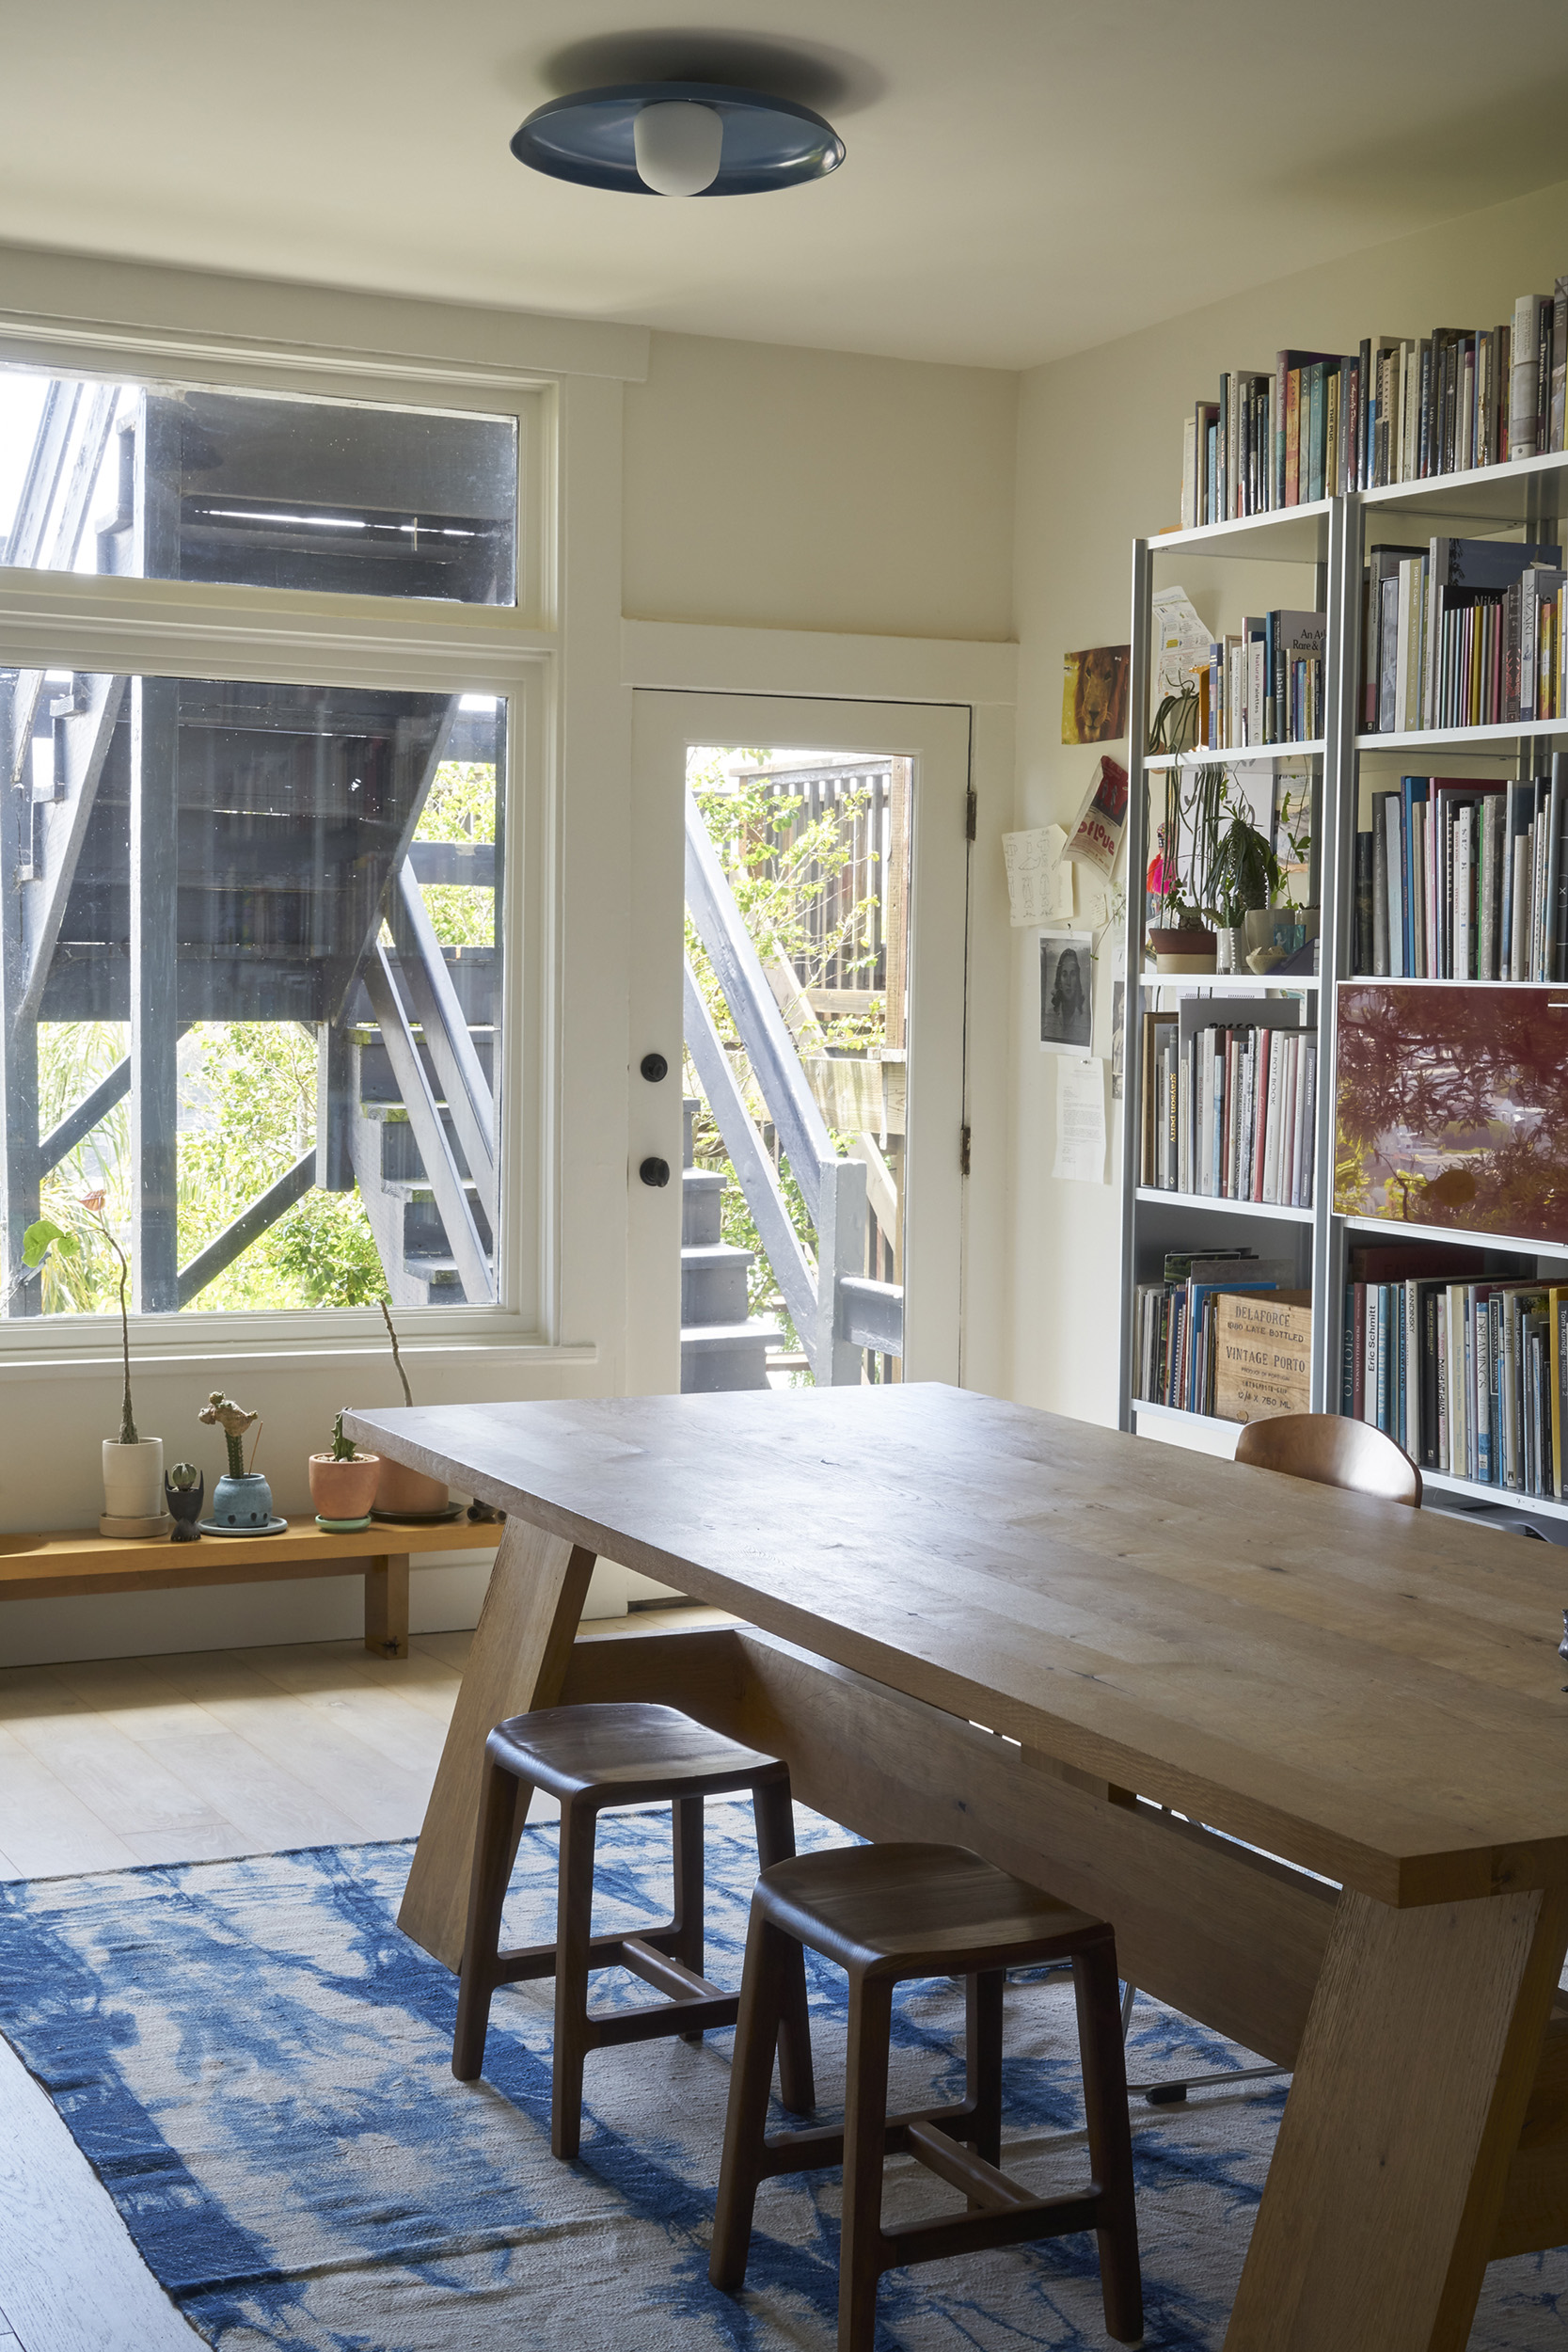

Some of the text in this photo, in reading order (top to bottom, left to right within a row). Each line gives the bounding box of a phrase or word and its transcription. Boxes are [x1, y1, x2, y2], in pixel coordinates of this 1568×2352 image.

[1539, 342, 1547, 384] Dream
[1475, 595, 1498, 607] Niki
[1525, 583, 1534, 638] MOZART
[1292, 639, 1318, 650] Rare &
[1301, 629, 1313, 639] An
[1235, 1305, 1291, 1327] DELAFORCE
[1245, 1325, 1266, 1335] LATE
[1269, 1328, 1304, 1343] BOTTLED
[1368, 1305, 1376, 1372] Eric Schmitt
[1226, 1345, 1306, 1374] VINTAGE PORTO
[1343, 1329, 1354, 1397] GIOTTO
[1477, 1315, 1487, 1389] DREAMINGS
[1378, 1371, 1386, 1382] IN
[1253, 1394, 1259, 1403] X
[1261, 1395, 1277, 1406] 750
[1279, 1399, 1291, 1409] ML
